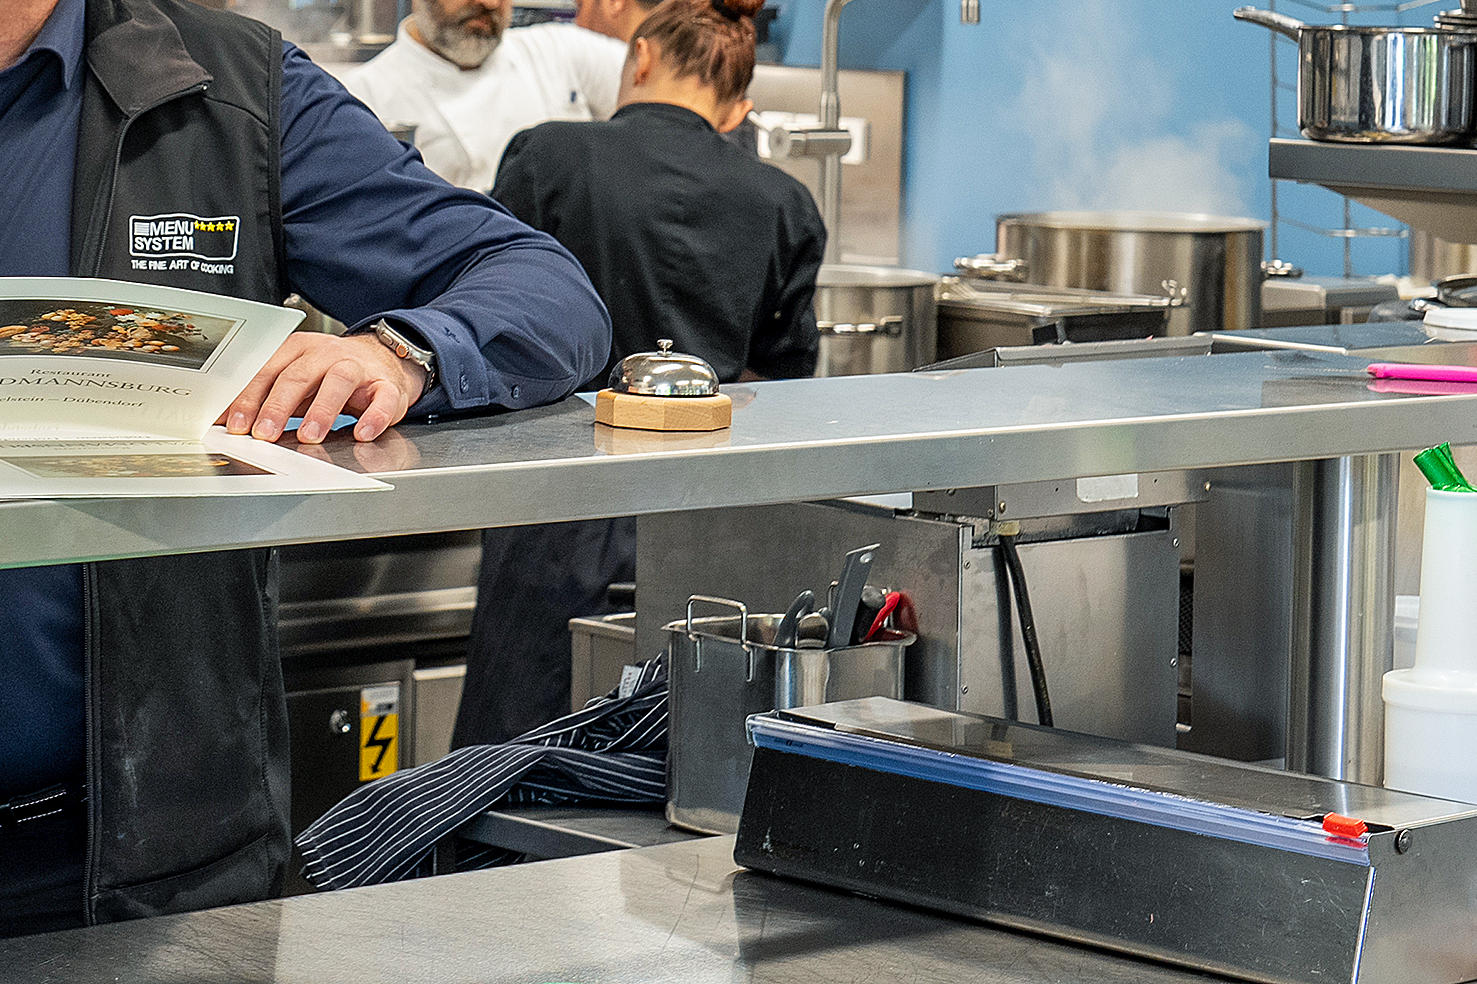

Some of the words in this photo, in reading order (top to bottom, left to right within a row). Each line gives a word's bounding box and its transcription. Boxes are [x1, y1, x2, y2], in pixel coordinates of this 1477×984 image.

[149, 220, 194, 235] MENU
[134, 235, 194, 251] SYSTEM
[131, 259, 147, 270] THE
[148, 260, 167, 271] FINE
[169, 259, 189, 270] ART
[190, 260, 200, 271] OF
[200, 262, 234, 275] COOKING
[30, 368, 111, 378] Restaurant
[62, 396, 146, 407] Dübendorf
